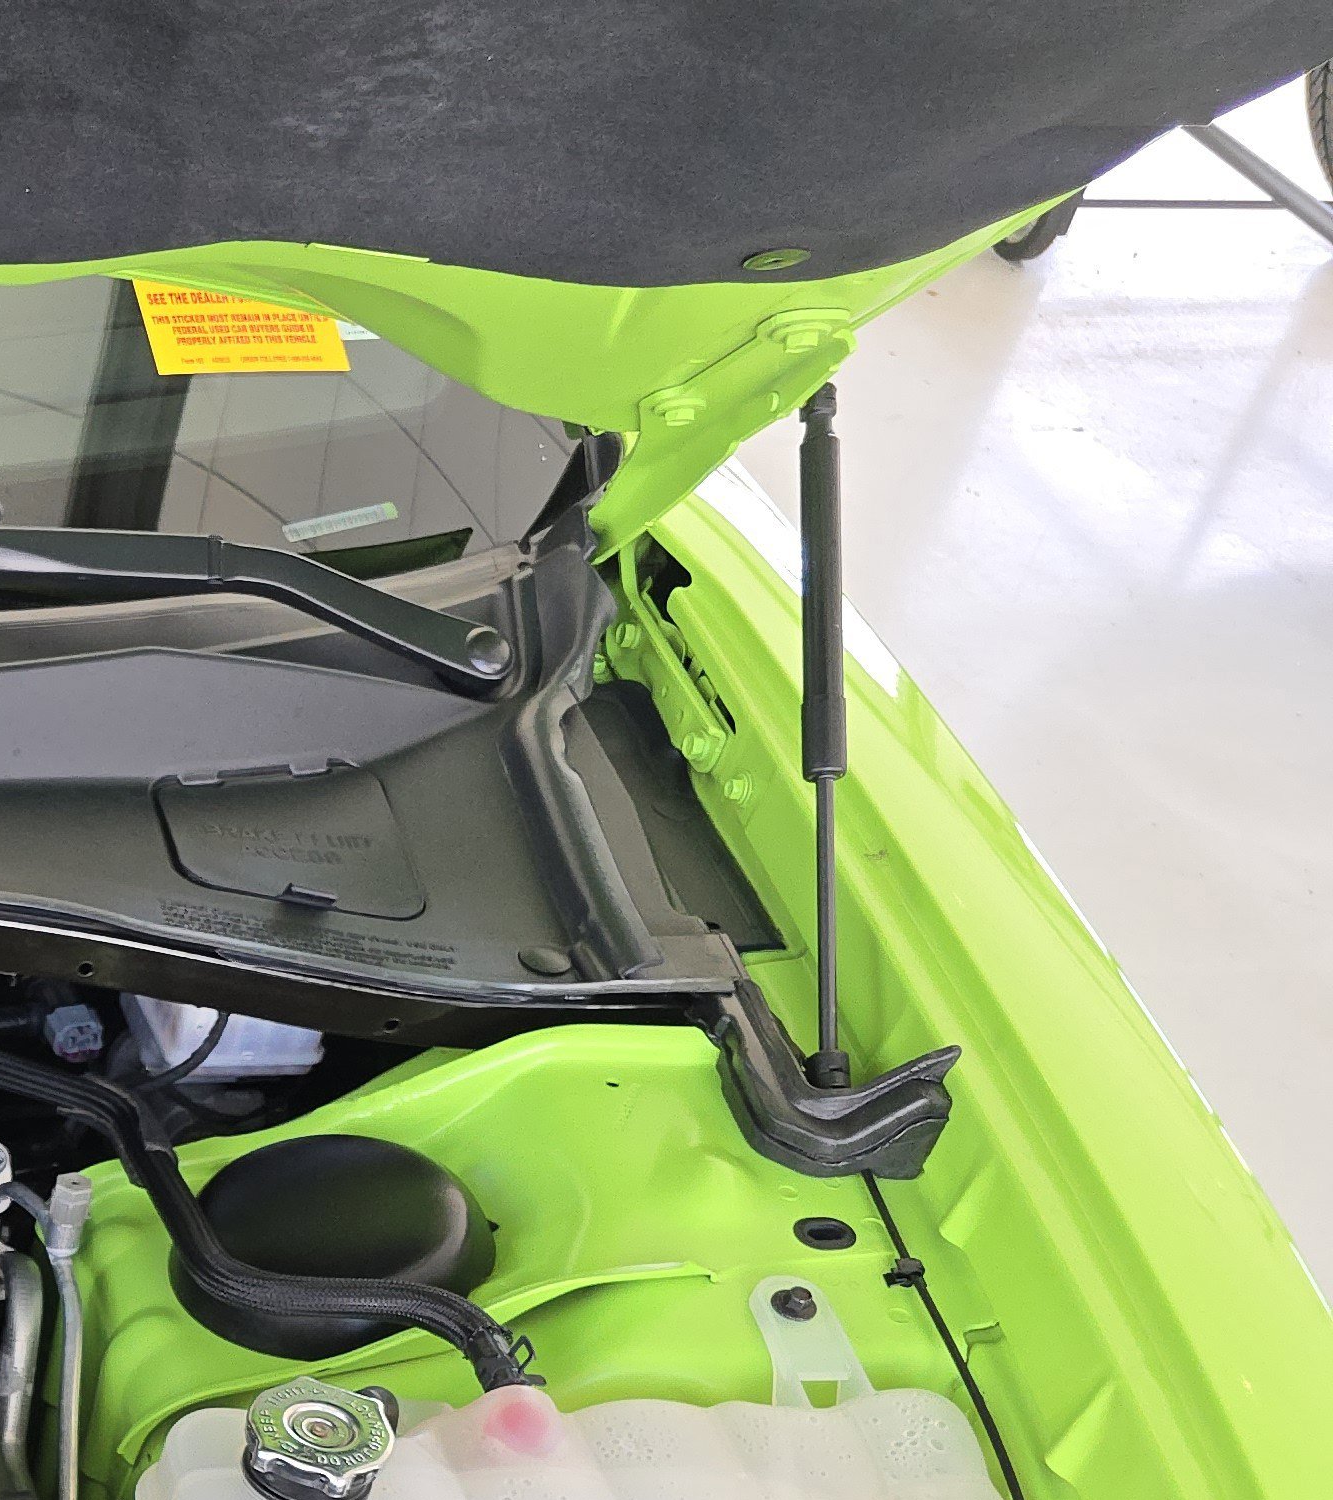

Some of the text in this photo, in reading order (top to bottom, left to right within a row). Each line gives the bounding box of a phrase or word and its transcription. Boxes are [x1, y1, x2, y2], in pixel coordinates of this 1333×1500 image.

[147, 293, 167, 305] SEE
[168, 292, 189, 305] THE
[152, 316, 170, 324] THIS
[172, 315, 205, 323] STICKER
[207, 314, 228, 322] MUST
[231, 313, 260, 322] REMAIN
[262, 313, 271, 322] IN
[273, 313, 296, 322] PLACE
[172, 325, 208, 334] FEDERAL
[209, 325, 229, 333] USED
[231, 324, 247, 333] CAR
[281, 324, 304, 333] GUIDE
[306, 324, 315, 332] IS
[177, 335, 317, 345] PROPERLY AFFIXED TO THIS VEHICLE
